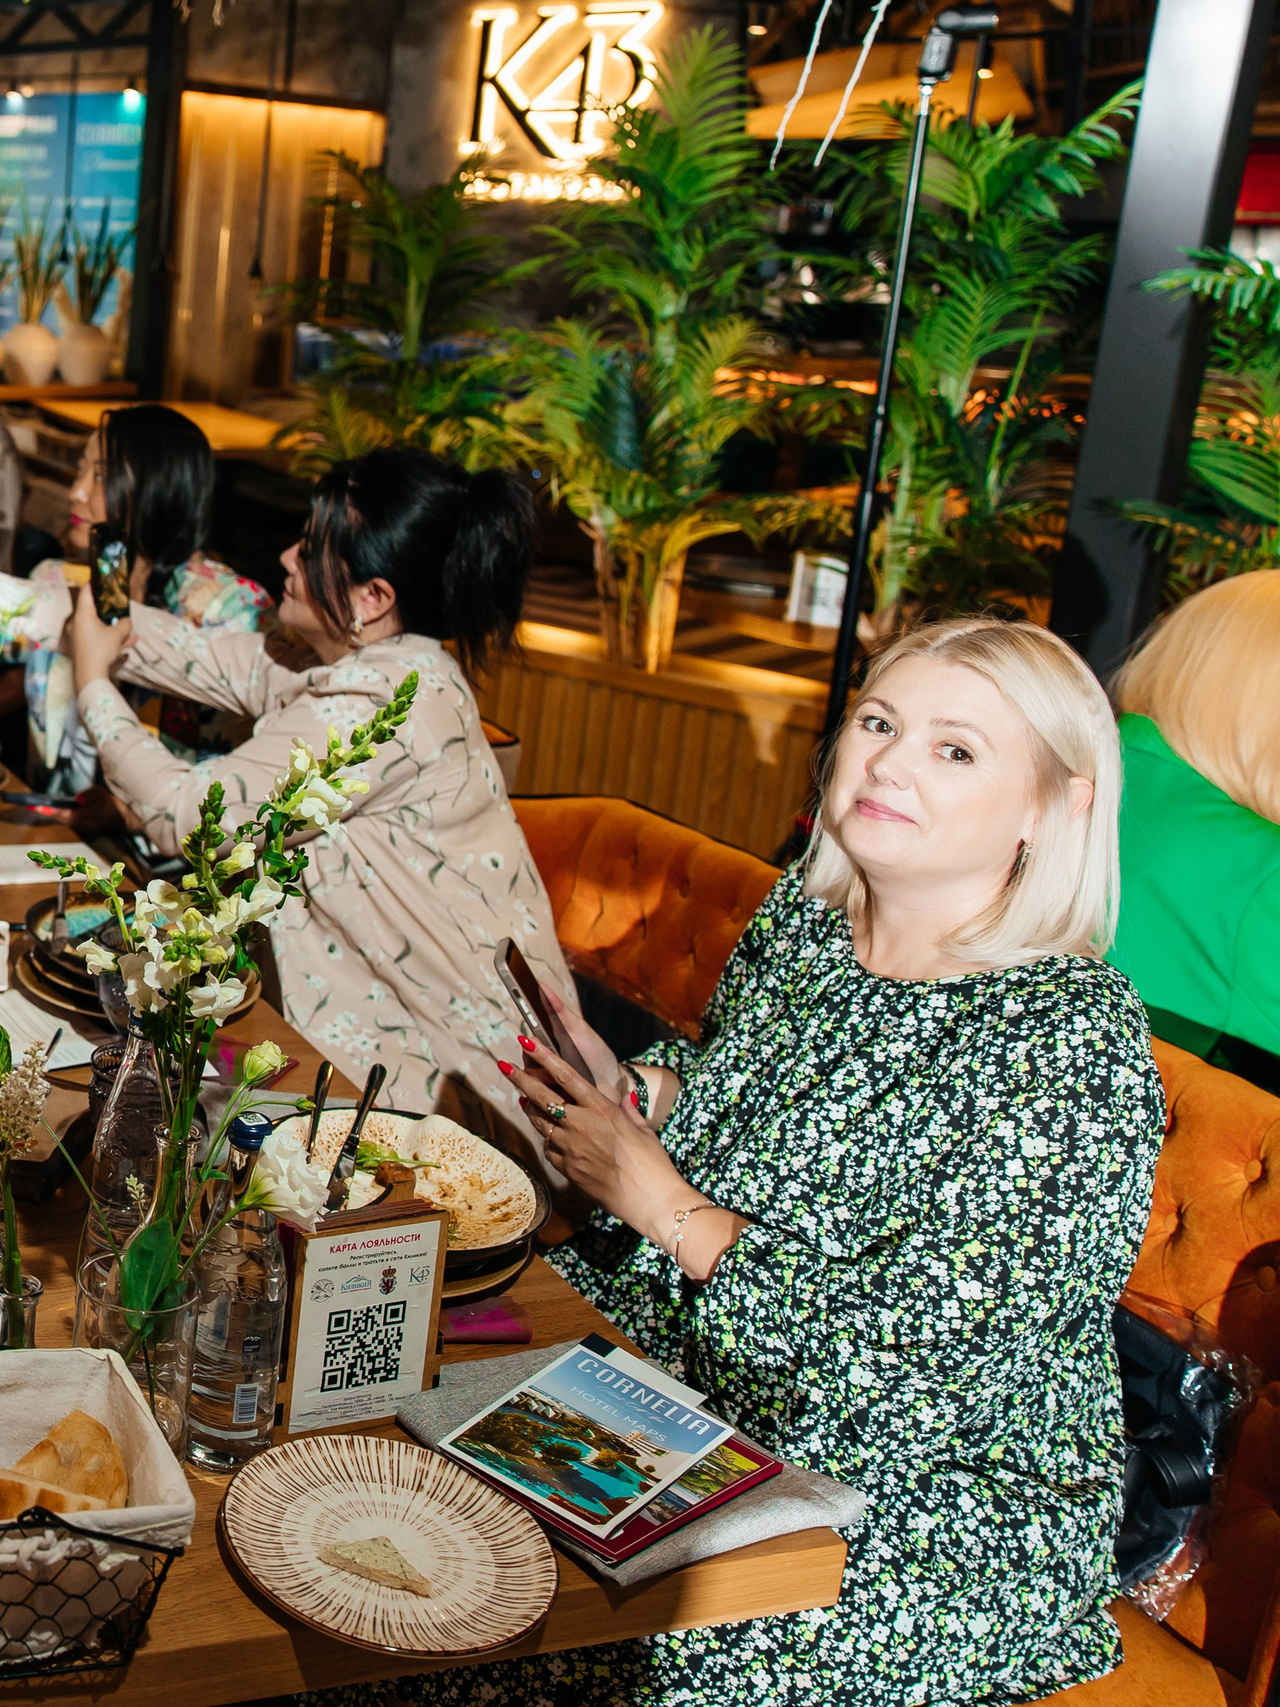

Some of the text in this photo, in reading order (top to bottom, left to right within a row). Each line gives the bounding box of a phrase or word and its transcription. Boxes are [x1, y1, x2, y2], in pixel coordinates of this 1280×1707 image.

[329, 1233, 421, 1254] КАРТА ЛОЯЛЬНОСТИ
[570, 1386, 619, 1418] HOTEL
[623, 1415, 668, 1442] MAPS
[577, 1358, 711, 1436] CORNELIA
